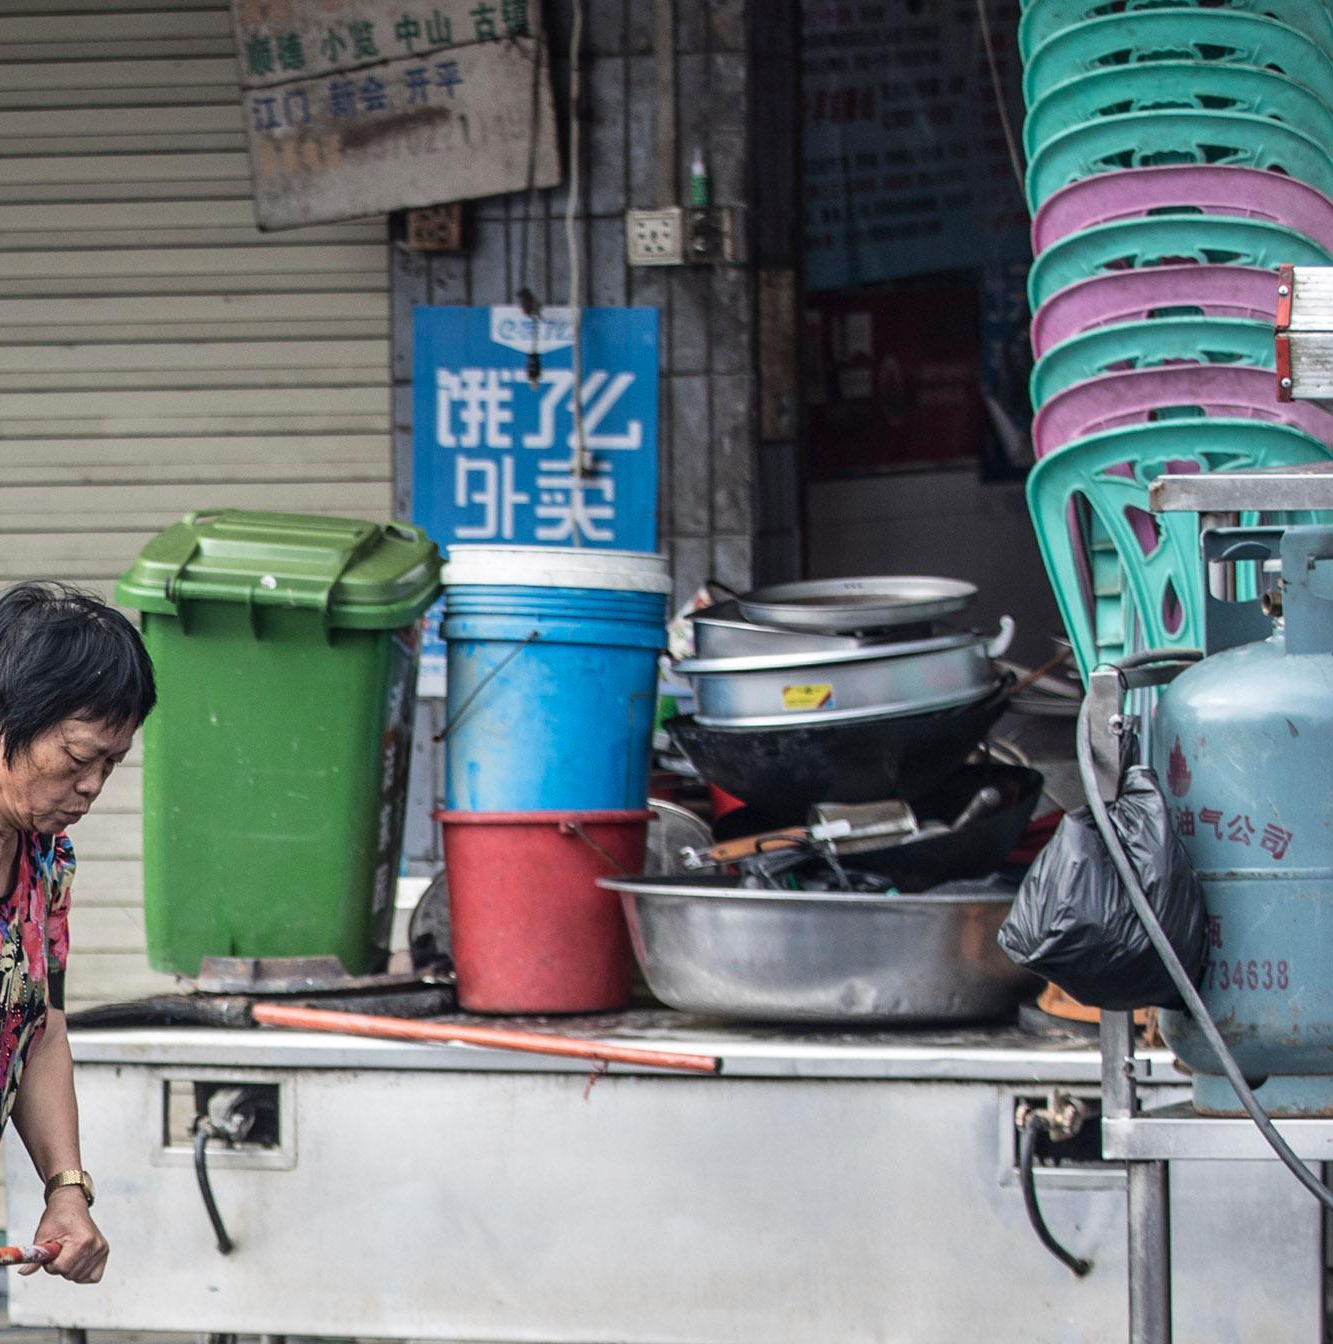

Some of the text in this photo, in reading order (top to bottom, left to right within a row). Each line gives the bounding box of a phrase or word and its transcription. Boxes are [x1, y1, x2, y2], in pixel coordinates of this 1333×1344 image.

[246, 33, 306, 75] 顺德
[394, 10, 453, 52] 中山
[469, 0, 529, 39] 古镇
[252, 60, 464, 132] 江门 新会 开平
[436, 367, 642, 450] 饿了么
[455, 452, 615, 541] 外卖
[1167, 806, 1293, 860] 油气公司
